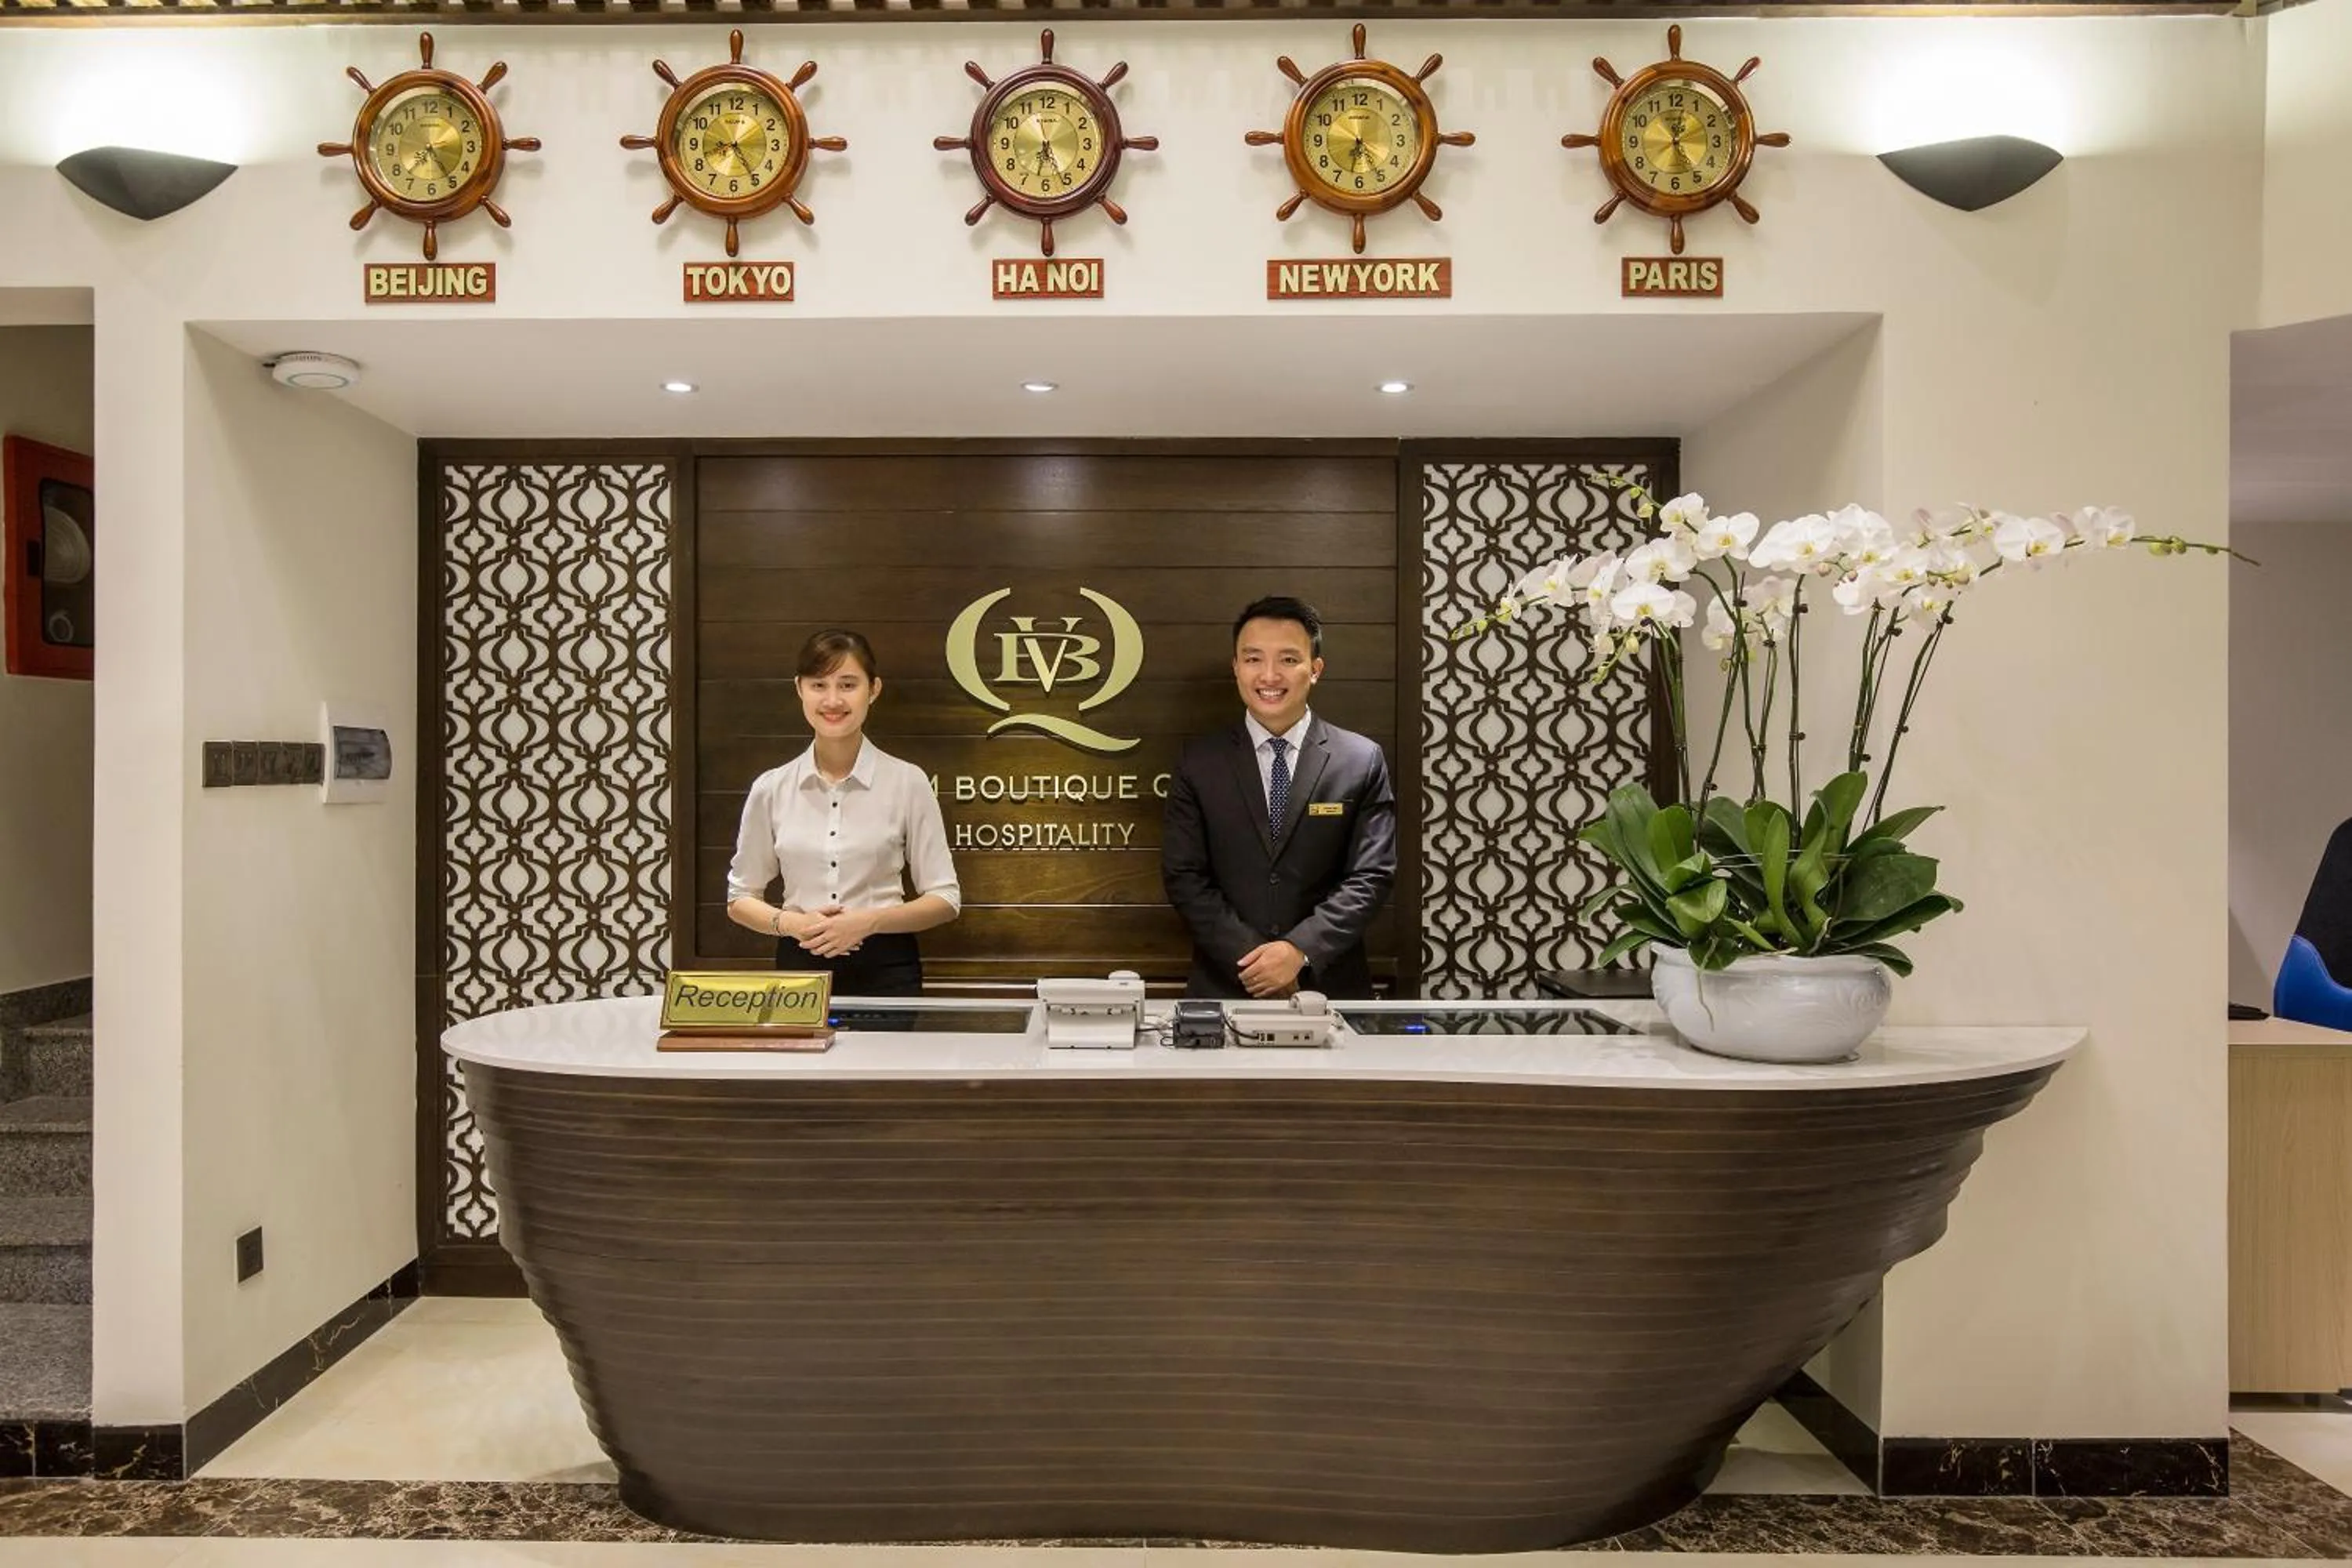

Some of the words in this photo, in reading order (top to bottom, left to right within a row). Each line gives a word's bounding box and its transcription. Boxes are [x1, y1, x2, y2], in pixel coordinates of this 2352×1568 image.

[729, 97, 743, 111] 12
[1039, 96, 1054, 108] 12
[1333, 99, 1345, 111] 11
[1352, 93, 1367, 105] 12
[1377, 99, 1382, 111] 1
[1668, 94, 1683, 107] 12
[422, 101, 438, 113] 12
[709, 103, 720, 115] 11
[753, 103, 758, 115] 1
[1020, 102, 1032, 114] 11
[1065, 102, 1070, 114] 1
[1648, 100, 1660, 112] 11
[1693, 100, 1699, 111] 1
[404, 108, 415, 119] 11
[447, 107, 452, 118] 1
[693, 118, 707, 130] 10
[766, 118, 775, 131] 2
[1004, 117, 1018, 129] 10
[1078, 117, 1087, 129] 2
[1317, 114, 1331, 125] 10
[1392, 114, 1400, 125] 2
[1632, 115, 1646, 127] 10
[1707, 114, 1715, 127] 2
[389, 122, 403, 135] 10
[462, 120, 470, 132] 2
[690, 138, 698, 151] 9
[771, 140, 780, 151] 3
[1001, 138, 1009, 149] 9
[1083, 138, 1091, 150] 3
[1314, 134, 1323, 147] 9
[1396, 135, 1405, 147] 3
[1629, 136, 1638, 147] 9
[1712, 136, 1721, 147] 3
[386, 143, 394, 155] 9
[466, 141, 476, 153] 3
[461, 162, 469, 172] 4
[695, 158, 703, 171] 8
[764, 159, 773, 172] 4
[1007, 158, 1015, 170] 8
[1077, 158, 1085, 170] 4
[1319, 155, 1328, 168] 8
[1390, 155, 1399, 167] 4
[1635, 157, 1643, 169] 8
[1706, 156, 1715, 168] 4
[393, 164, 401, 176] 8
[1333, 170, 1342, 182] 7
[1377, 169, 1385, 182] 5
[449, 176, 456, 188] 5
[709, 174, 717, 186] 7
[751, 174, 760, 186] 5
[1020, 173, 1029, 185] 7
[1063, 172, 1072, 185] 5
[1355, 176, 1363, 188] 6
[1650, 172, 1658, 183] 7
[1693, 171, 1702, 183] 5
[405, 179, 414, 190] 7
[427, 183, 436, 195] 6
[729, 180, 738, 192] 6
[1041, 179, 1050, 191] 6
[1671, 177, 1679, 190] 6
[369, 267, 487, 296] BEIJING
[687, 267, 790, 296] TOKYO
[1279, 263, 1439, 292] NEWYORK
[1629, 262, 1717, 290] PARIS
[956, 775, 1138, 802] BOUTIQUE
[956, 823, 1134, 846] HOSPITALITY
[674, 985, 817, 1013] Reception
